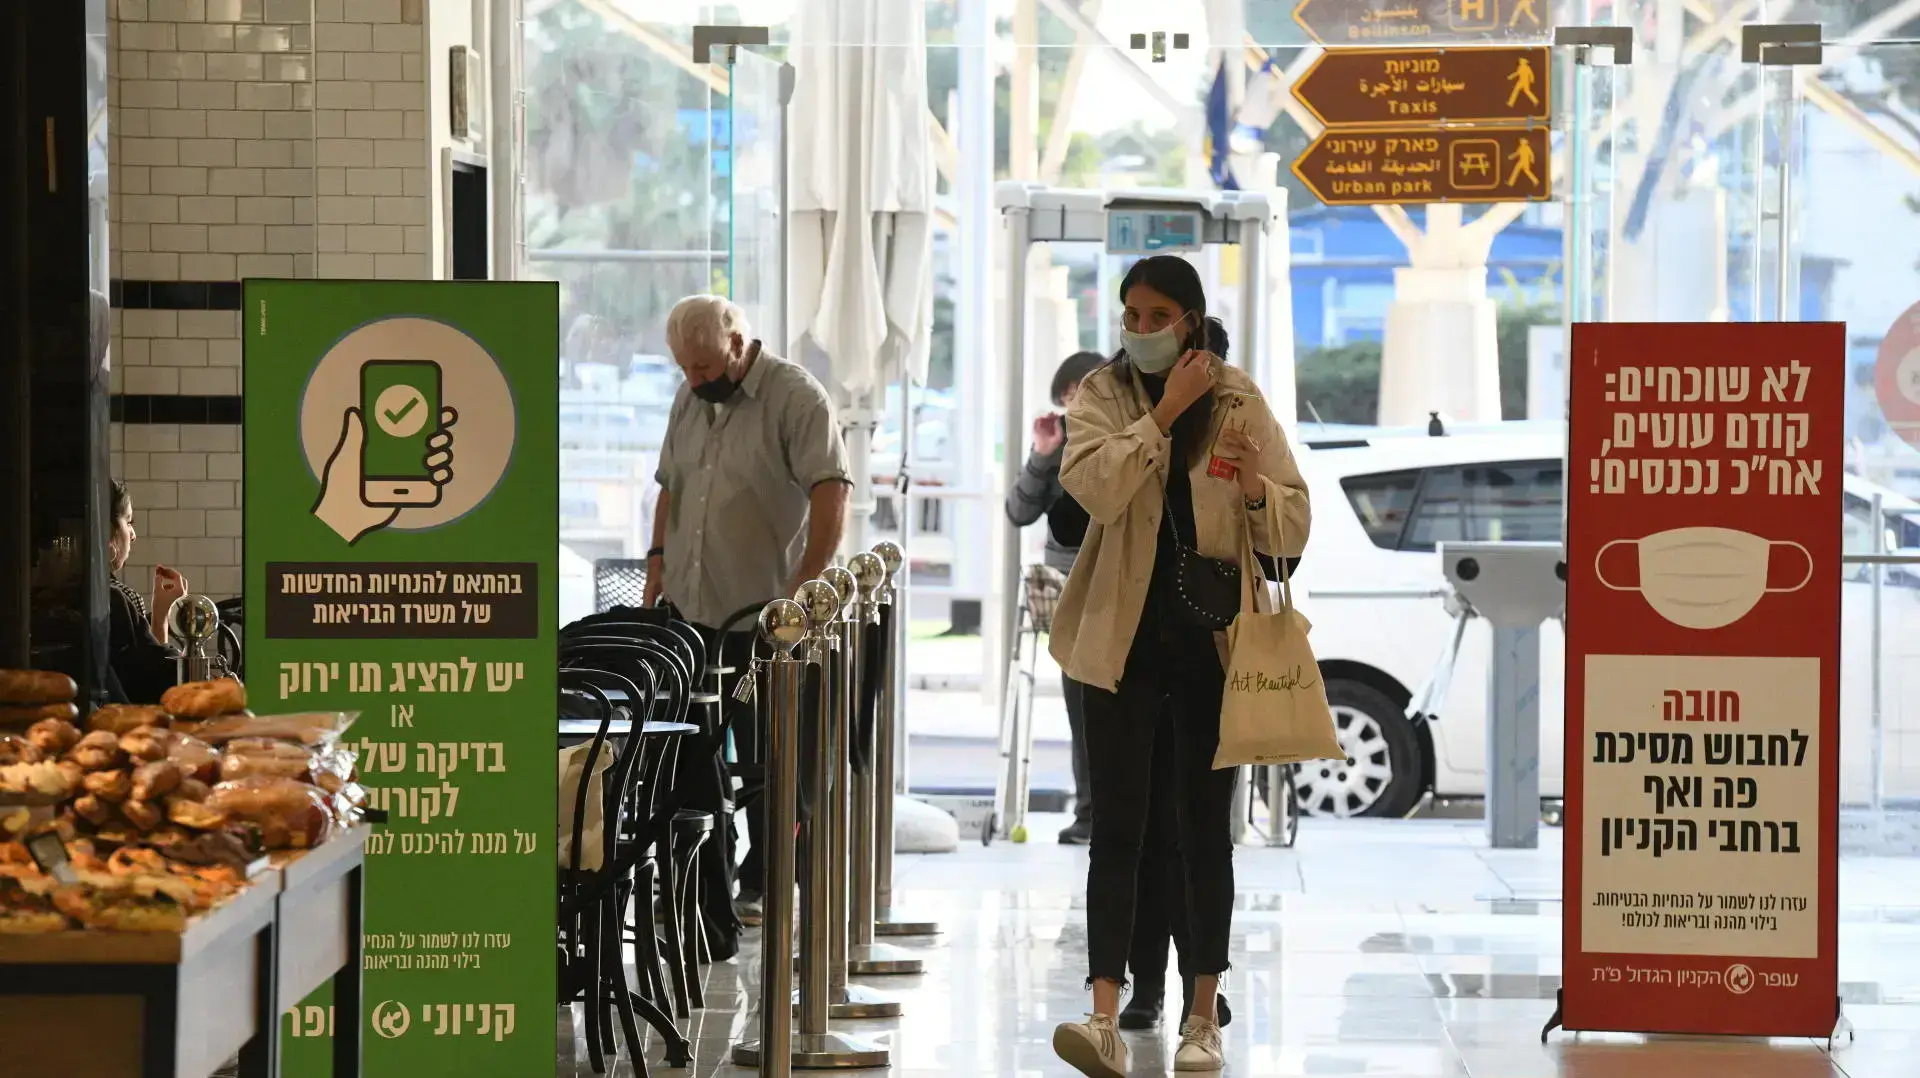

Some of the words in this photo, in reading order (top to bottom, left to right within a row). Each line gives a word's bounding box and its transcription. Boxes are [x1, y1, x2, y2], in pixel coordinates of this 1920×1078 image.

[1384, 59, 1440, 74] מוניות
[1416, 77, 1465, 94] سيارات
[1388, 100, 1438, 113] Taxis
[1326, 140, 1376, 155] עירוני
[1385, 138, 1439, 156] פארק
[1326, 160, 1372, 174] العامة
[1382, 159, 1440, 176] الحديقة
[1332, 180, 1385, 194] Urban
[1392, 179, 1432, 196] park
[1606, 366, 1750, 402] שוכחים:
[1762, 360, 1811, 402] לא
[1601, 413, 1714, 457] עוטים,
[1726, 413, 1809, 457] קודם
[1590, 459, 1719, 494] נכנסים!
[281, 573, 362, 594] החדשות
[368, 569, 446, 594] להנחיות
[453, 573, 522, 594] בהתאם
[313, 604, 394, 624] הבריאות
[401, 604, 455, 624] משרד
[462, 600, 491, 624] של
[280, 662, 339, 699] ירוק
[348, 662, 382, 692] תו
[390, 656, 477, 692] להציג
[486, 663, 524, 692] יש
[1231, 670, 1254, 692] Act
[1256, 665, 1316, 699] Beautiful
[1664, 690, 1740, 721] חובה
[391, 704, 414, 728] או
[1593, 732, 1693, 763] מסיכת
[1705, 729, 1809, 766] לחבוש
[416, 742, 506, 779] בדיקה
[1645, 776, 1702, 814] ואף
[1714, 776, 1757, 808] פה
[402, 829, 465, 855] להיכנס
[471, 833, 507, 855] מנת
[514, 829, 537, 855] על
[1602, 818, 1697, 857] הקניון
[1709, 820, 1800, 853] ברחבי
[1593, 892, 1648, 907] הבטיחות.
[1652, 894, 1693, 908] הנחיות
[1698, 892, 1712, 909] על
[1717, 894, 1754, 910] לשמור
[1760, 895, 1776, 910] לנו
[1781, 896, 1807, 911] עזרו
[1622, 912, 1659, 927] לכולם!
[1664, 914, 1709, 928] ובריאות
[1715, 916, 1746, 930] מהנה
[1751, 914, 1777, 930] בילוי
[400, 932, 414, 948] על
[420, 932, 458, 948] לשמור
[463, 932, 480, 948] לנו
[484, 933, 511, 948] עזרו
[364, 954, 411, 969] ובריאות
[417, 954, 448, 968] מהנה
[454, 952, 480, 968] בילוי
[1627, 966, 1672, 983] הגדול
[1678, 970, 1721, 988] הקניון
[1759, 973, 1798, 986] עופר
[288, 1006, 335, 1037] ופר
[423, 1004, 515, 1040] קניוני
